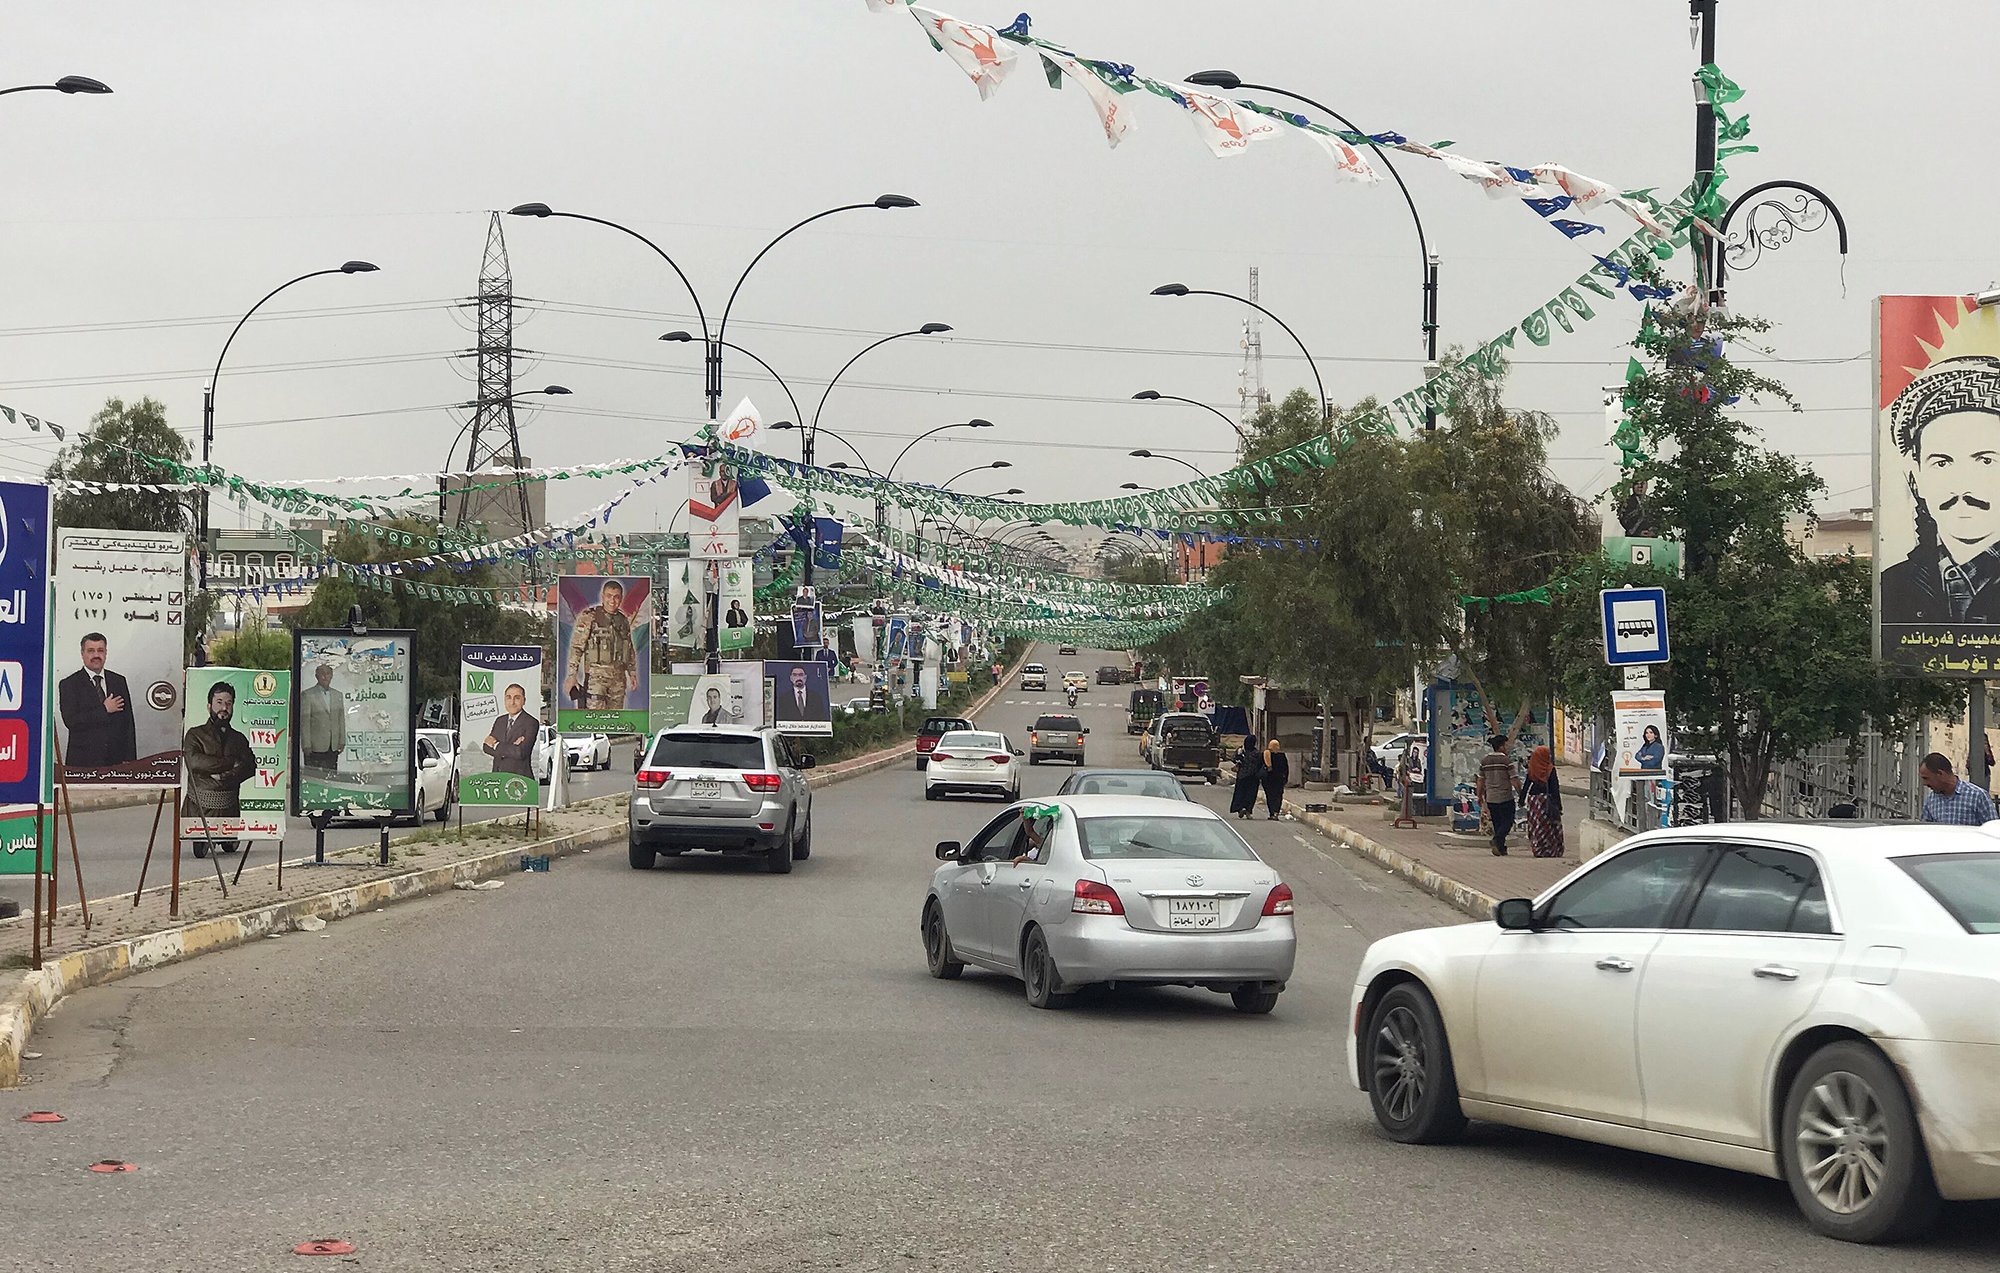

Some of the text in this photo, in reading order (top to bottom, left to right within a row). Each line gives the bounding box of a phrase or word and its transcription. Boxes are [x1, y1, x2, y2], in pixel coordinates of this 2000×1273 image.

[467, 652, 483, 660] الله
[508, 653, 534, 662] مقداد
[469, 674, 491, 692] ١٨
[152, 756, 178, 766] لیستی
[64, 769, 98, 780] کوردستا
[1176, 901, 1214, 911] ١٨٧١٠٢
